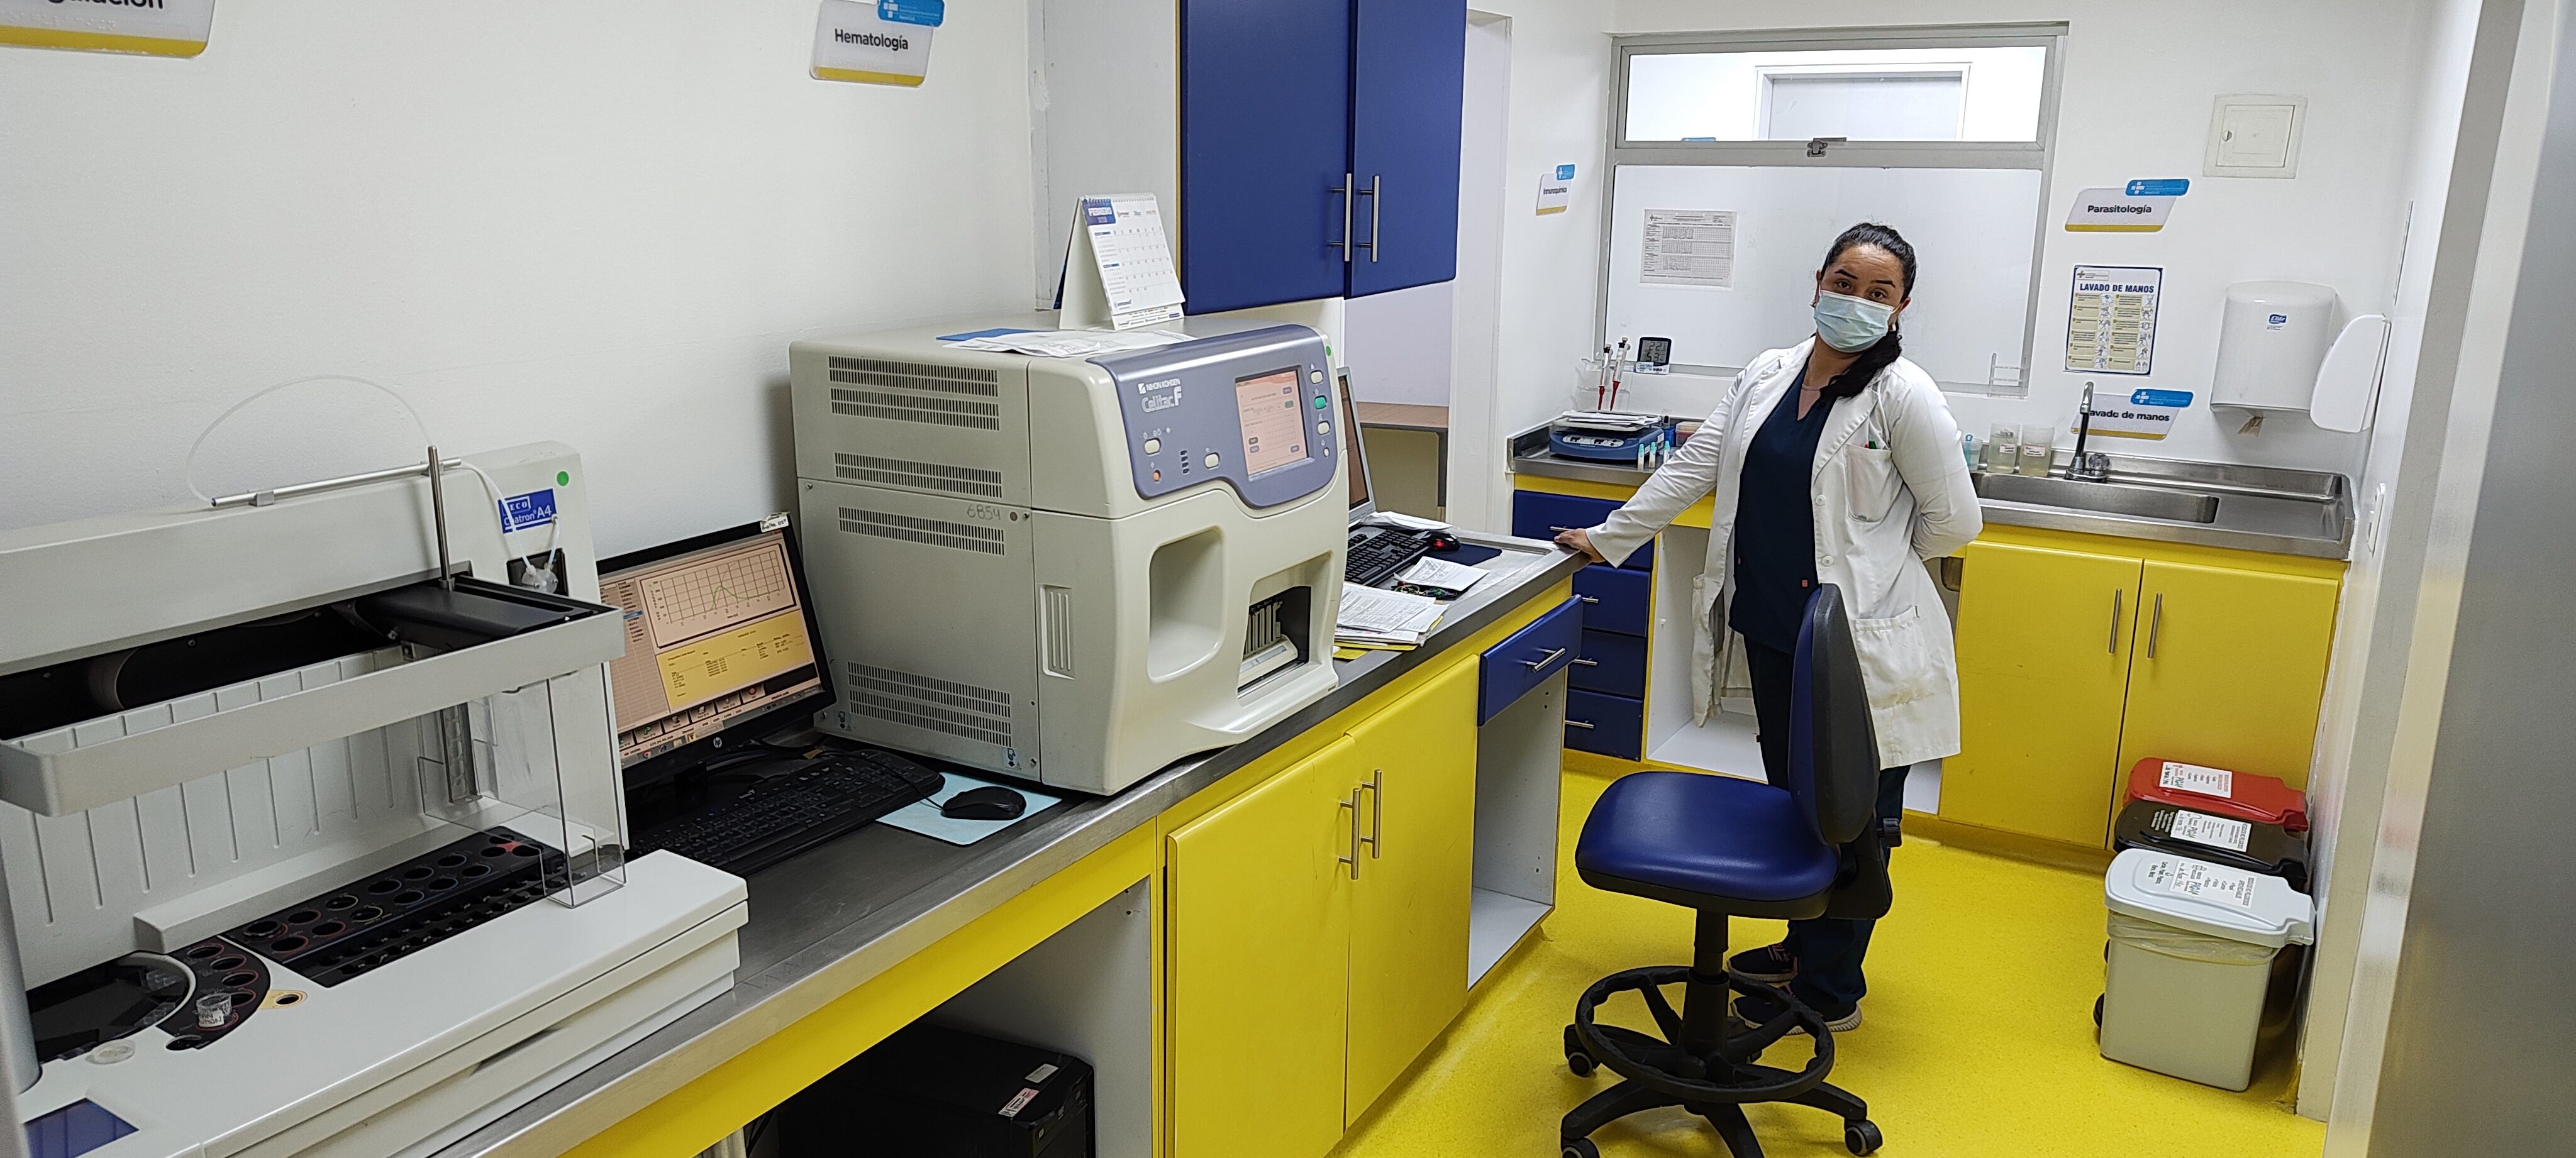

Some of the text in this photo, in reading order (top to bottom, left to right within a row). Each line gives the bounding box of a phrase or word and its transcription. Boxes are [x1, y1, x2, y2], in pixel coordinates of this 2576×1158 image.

[835, 28, 908, 51] Hematología
[2087, 204, 2151, 214] Parasitología
[2125, 285, 2154, 293] MANOS
[2089, 409, 2170, 421] avado de manos
[508, 501, 528, 511] ECO
[504, 504, 552, 526] Catron A4
